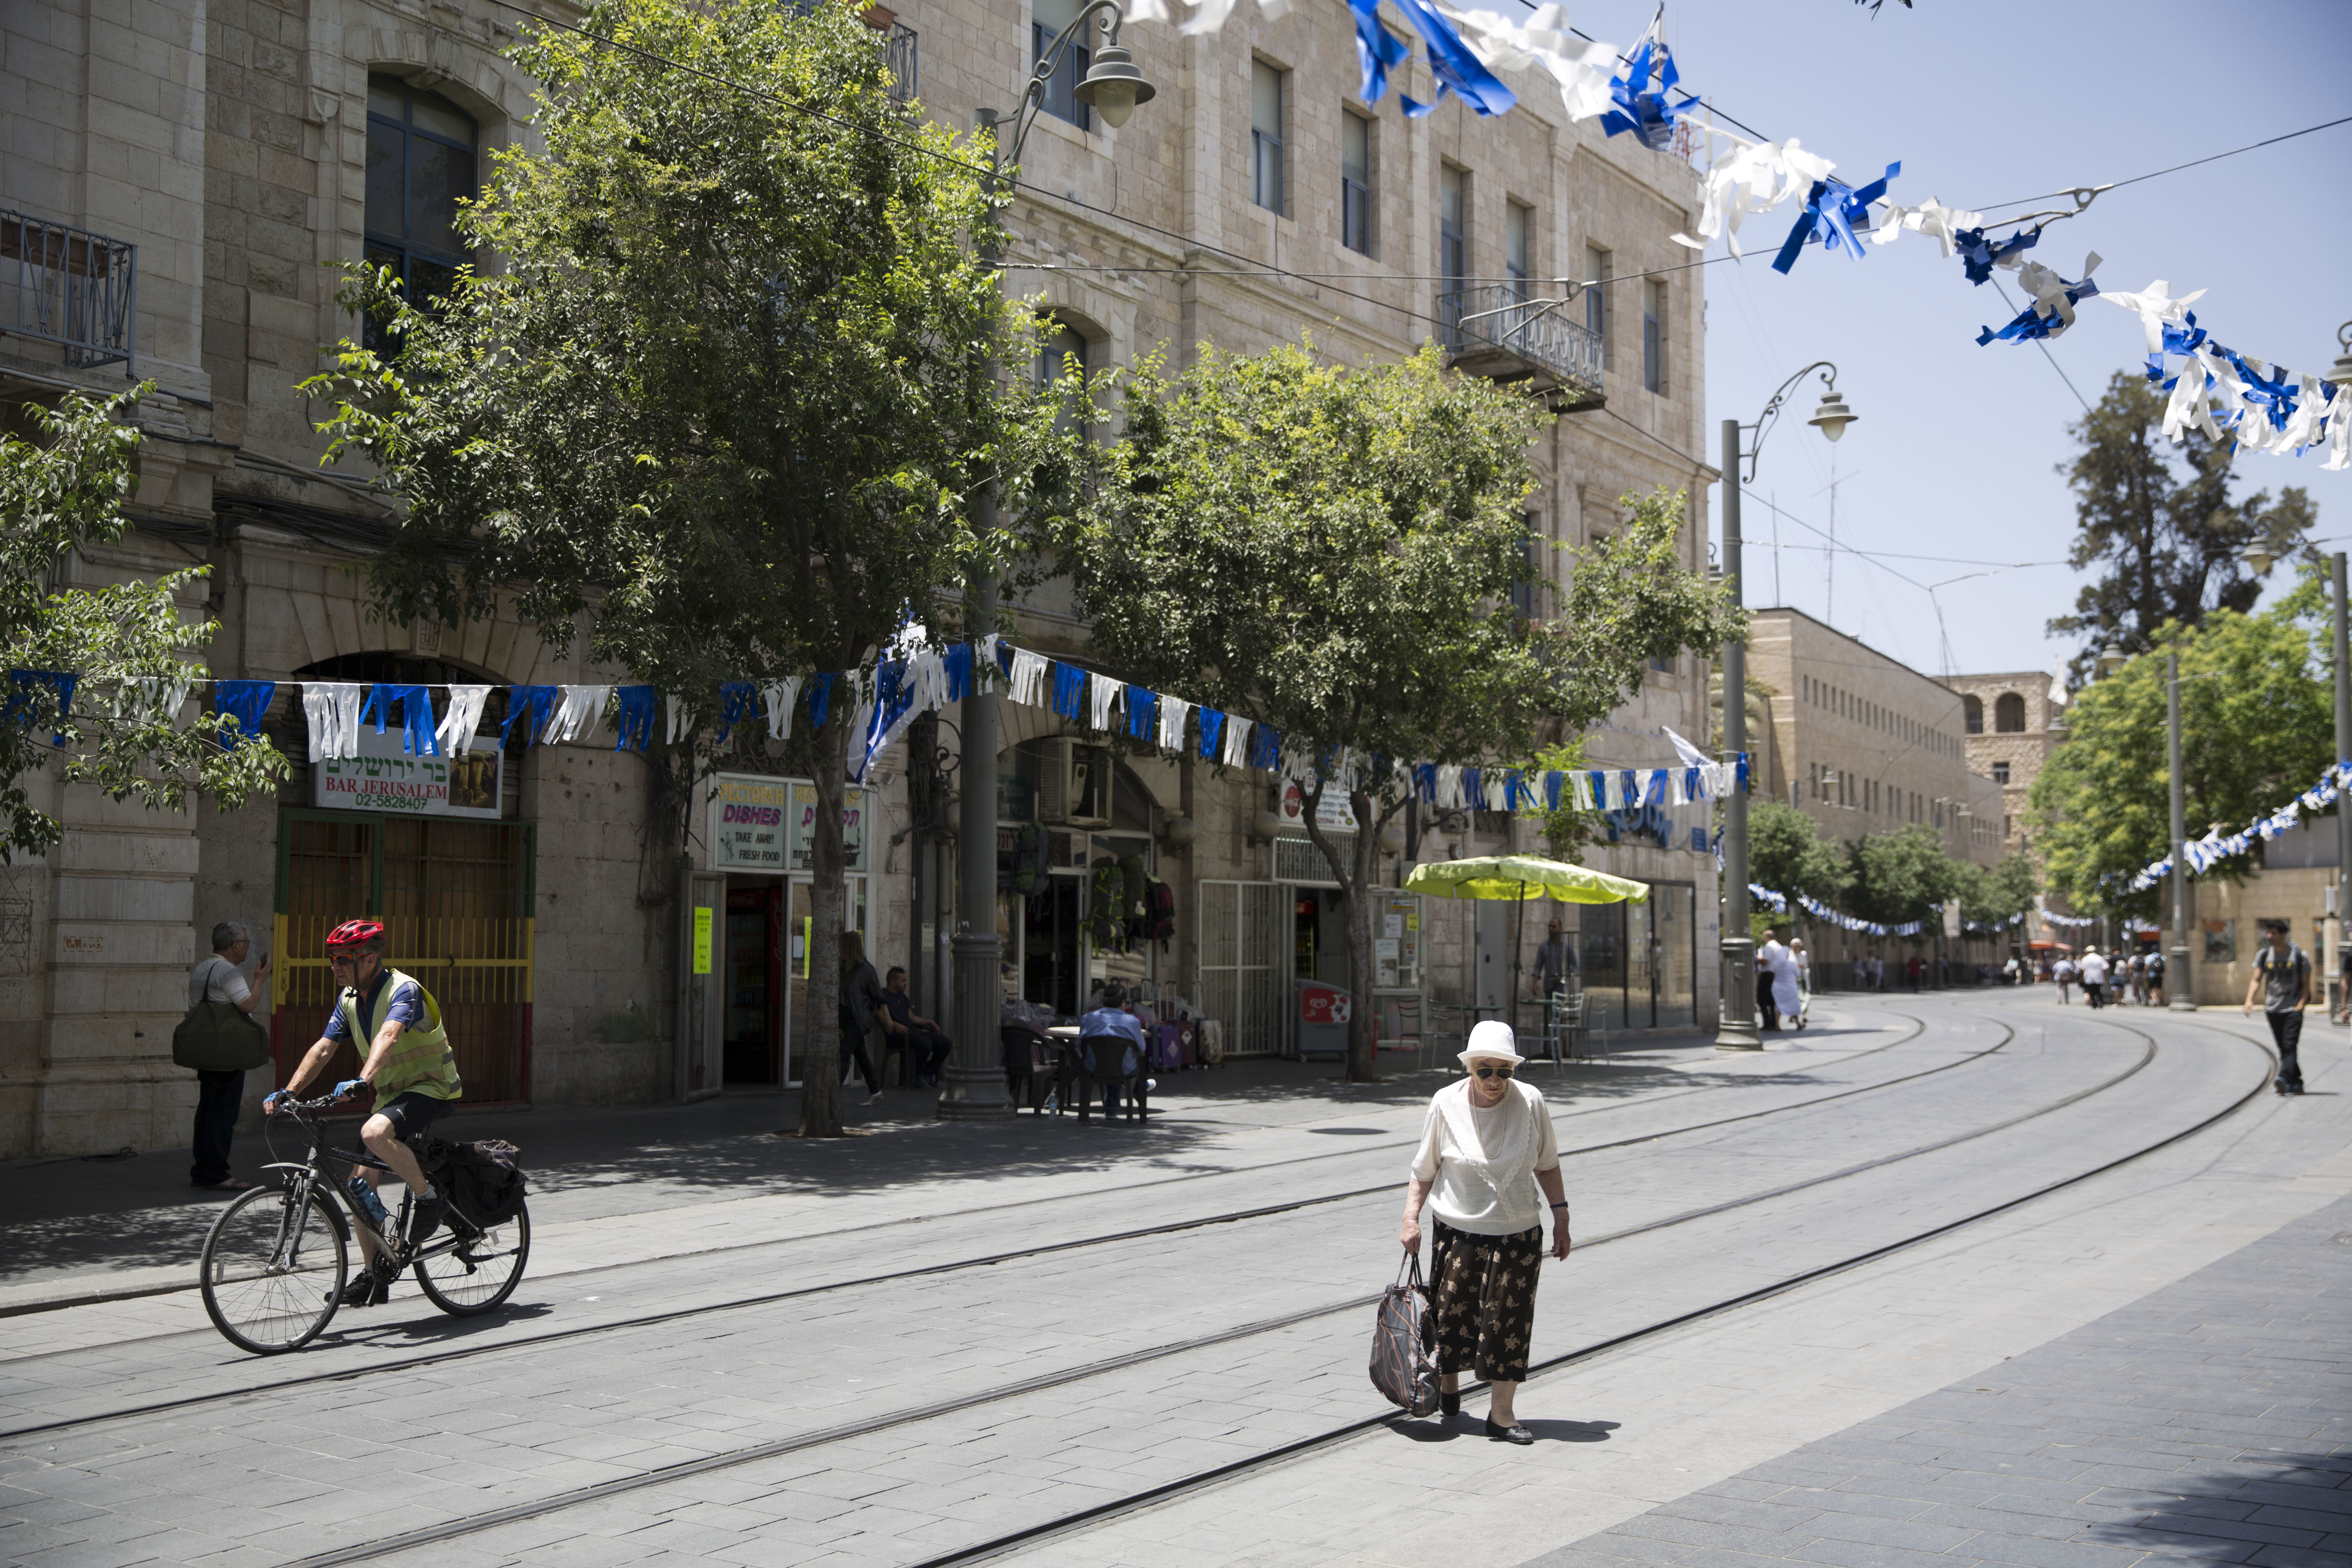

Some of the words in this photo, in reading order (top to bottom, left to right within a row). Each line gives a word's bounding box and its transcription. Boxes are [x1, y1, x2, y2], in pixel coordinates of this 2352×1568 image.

[327, 756, 414, 779] ירושלים
[422, 762, 446, 782] בר
[326, 777, 357, 792] BAR
[362, 780, 448, 799] JERUSALEM
[719, 784, 784, 805] РЕСТОРАН
[355, 793, 428, 810] 02-5828407
[723, 804, 781, 826] DISHES
[735, 832, 752, 842] TAKE
[756, 833, 774, 844] AWAY!
[739, 850, 760, 860] FRESH
[762, 851, 780, 861] FOOD
